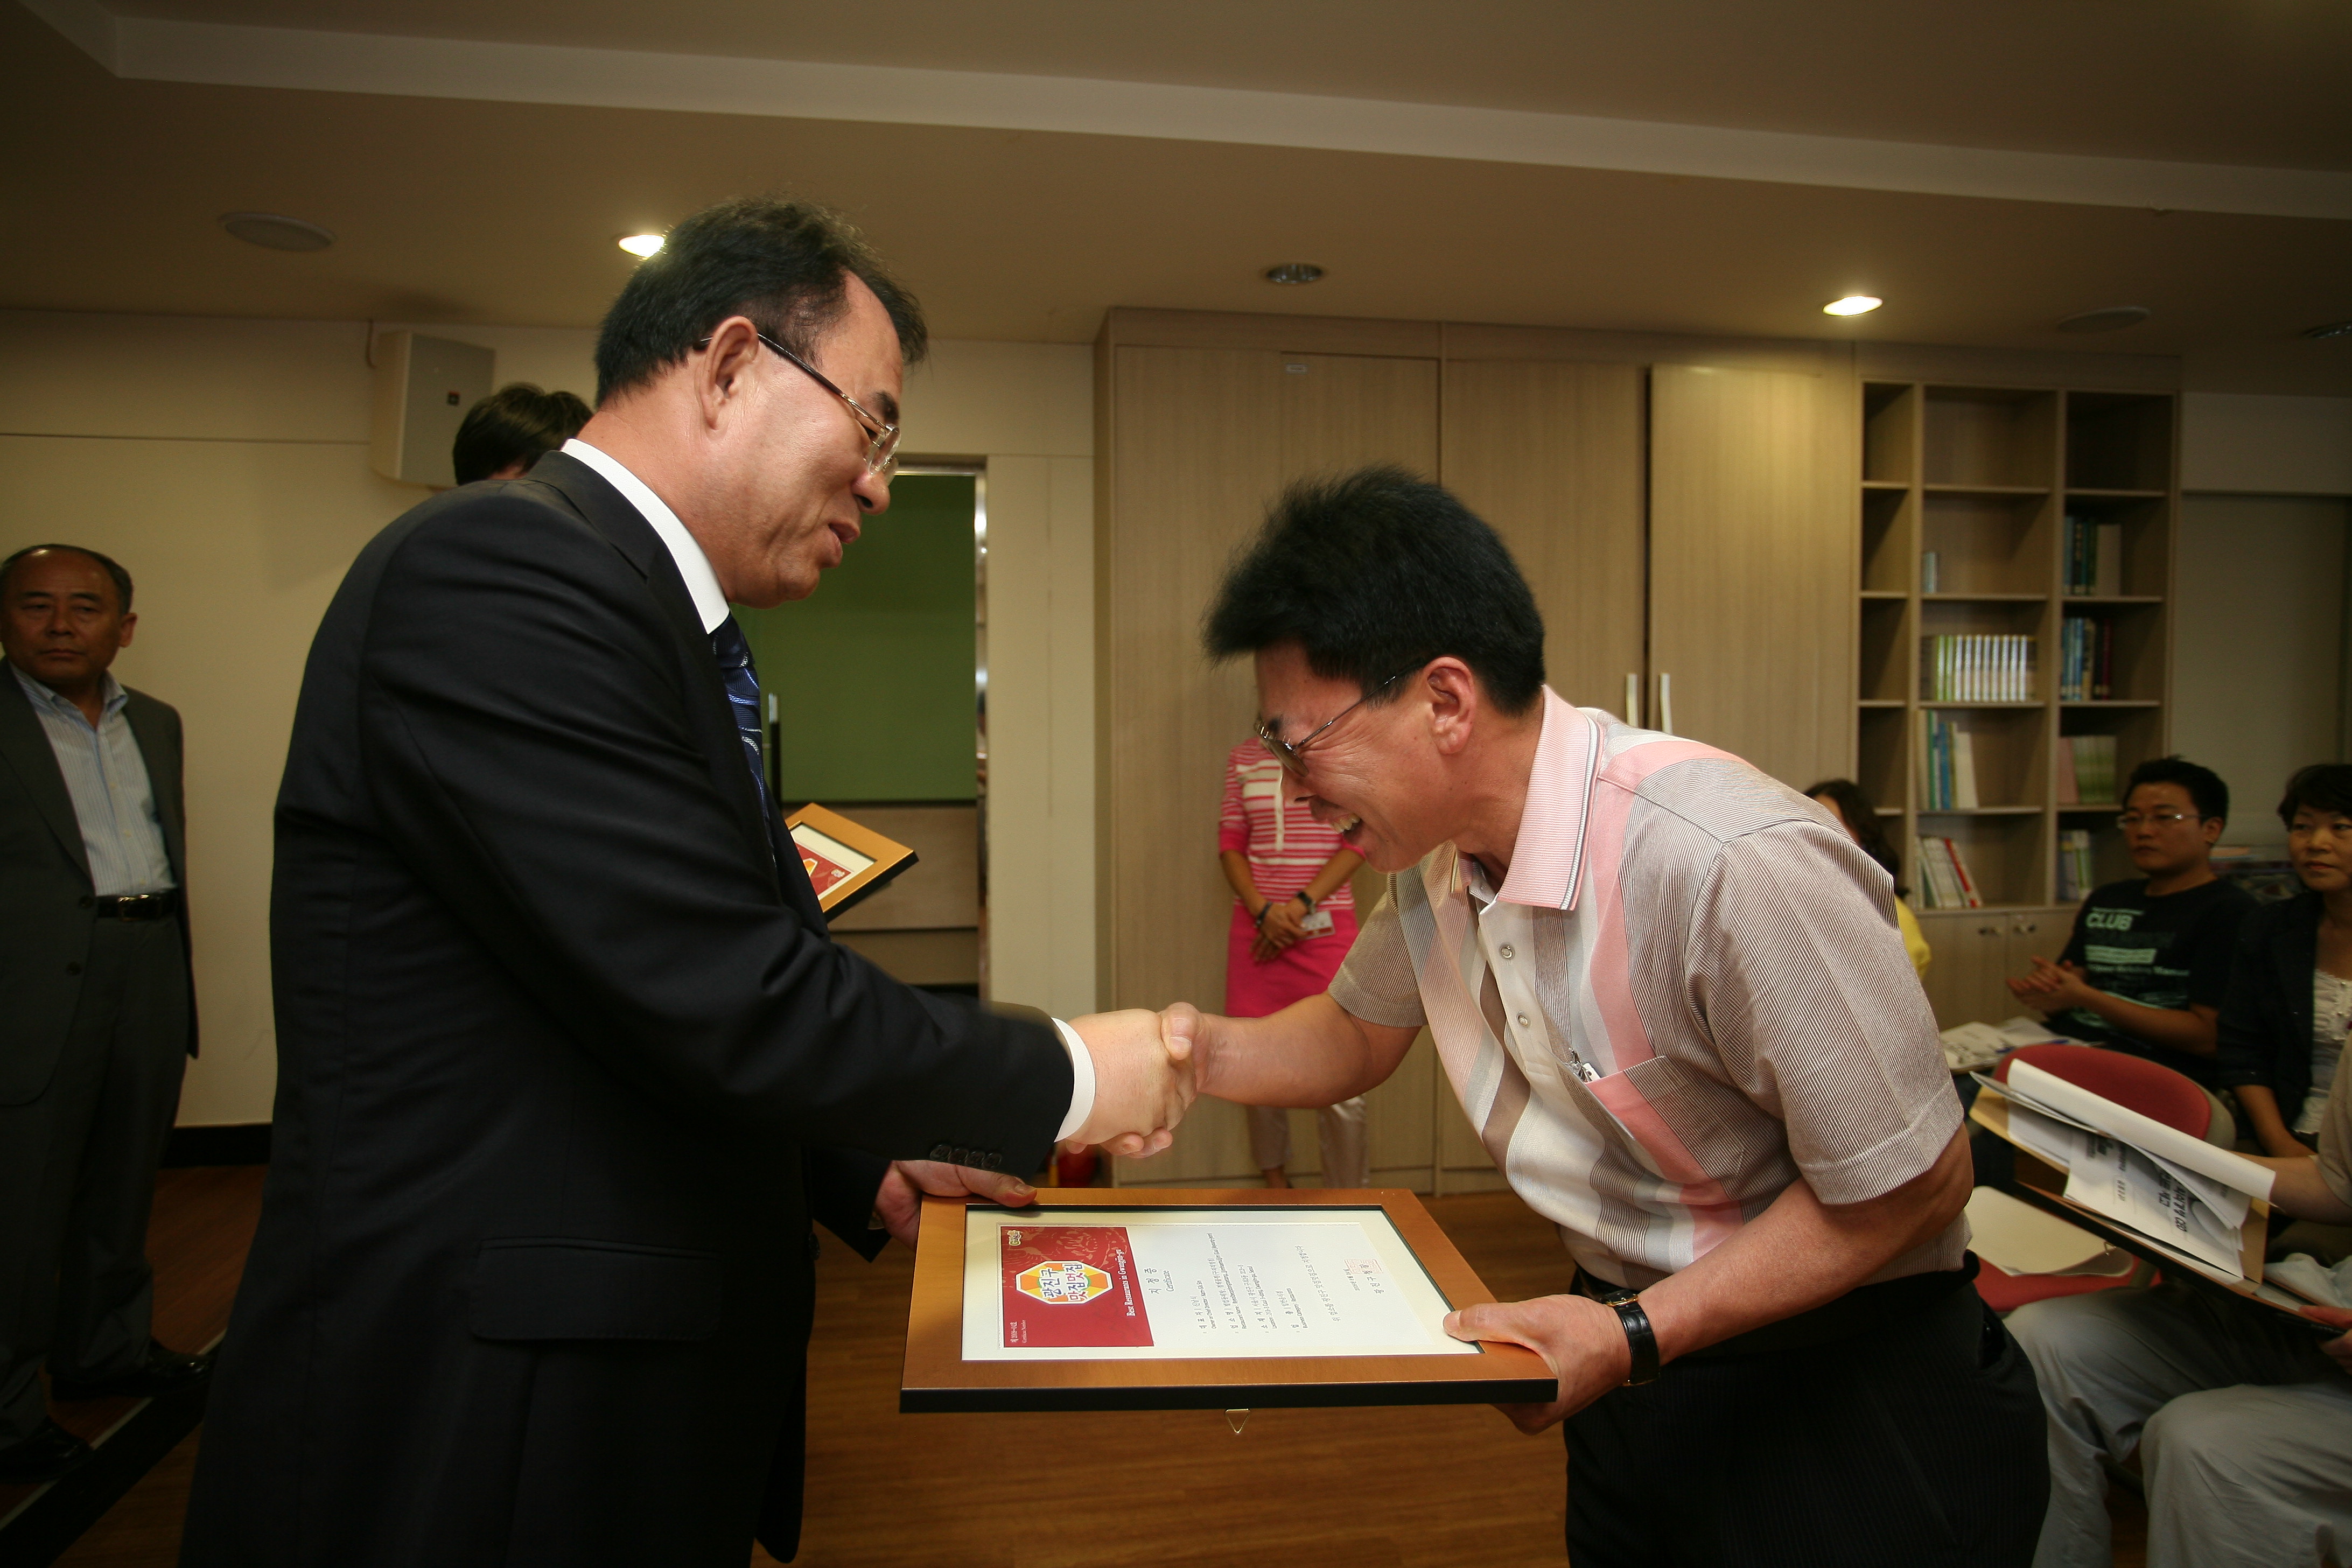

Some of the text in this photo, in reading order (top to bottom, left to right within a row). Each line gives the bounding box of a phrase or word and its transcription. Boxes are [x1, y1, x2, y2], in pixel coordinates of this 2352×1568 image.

[2085, 912, 2133, 931] CLUB
[1115, 1249, 1126, 1275] Gwangjin-gu
[1041, 1268, 1061, 1298] 광진구
[1064, 1264, 1087, 1301] 맛집멋집
[1123, 1280, 1133, 1305] Restaurants
[1164, 1271, 1174, 1292] Certificate
[1318, 1290, 1331, 1302] 광진구
[1126, 1306, 1136, 1317] Best
